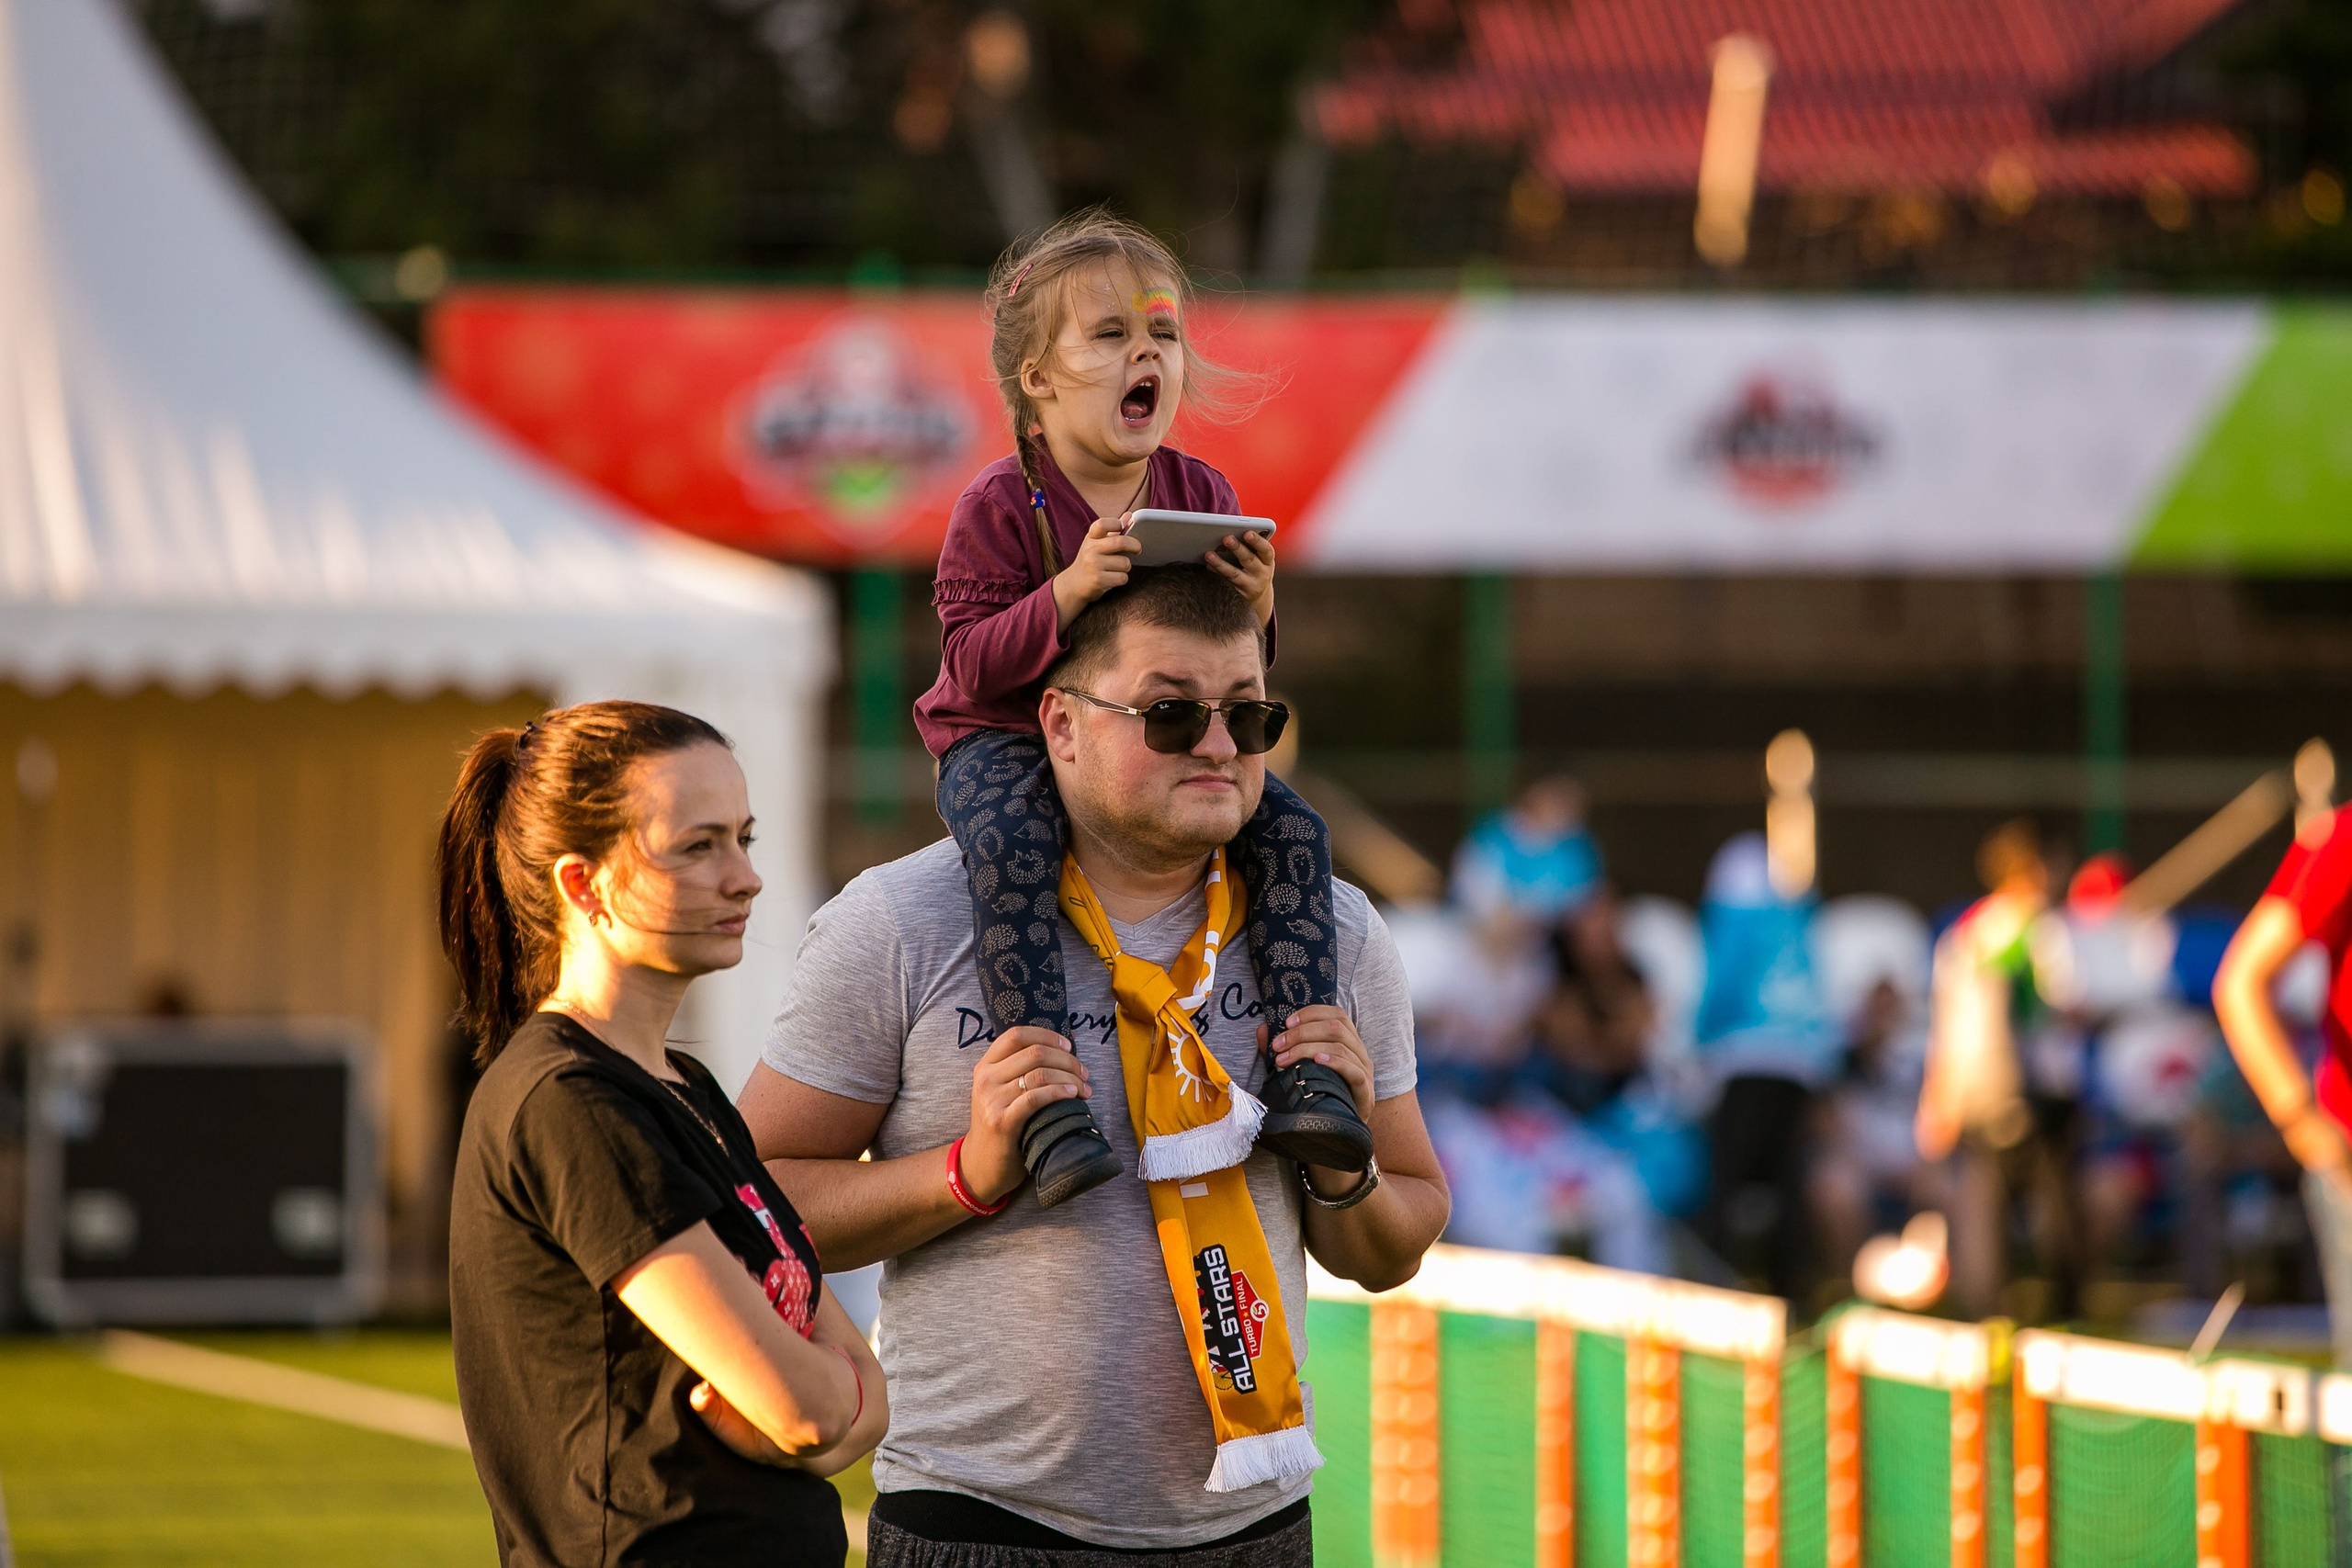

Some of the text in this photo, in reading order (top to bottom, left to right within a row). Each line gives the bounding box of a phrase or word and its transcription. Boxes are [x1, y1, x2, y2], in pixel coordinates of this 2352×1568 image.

[1204, 1247, 1254, 1391] ALL STARS
[1237, 1278, 1258, 1354] TURBO FINAL
